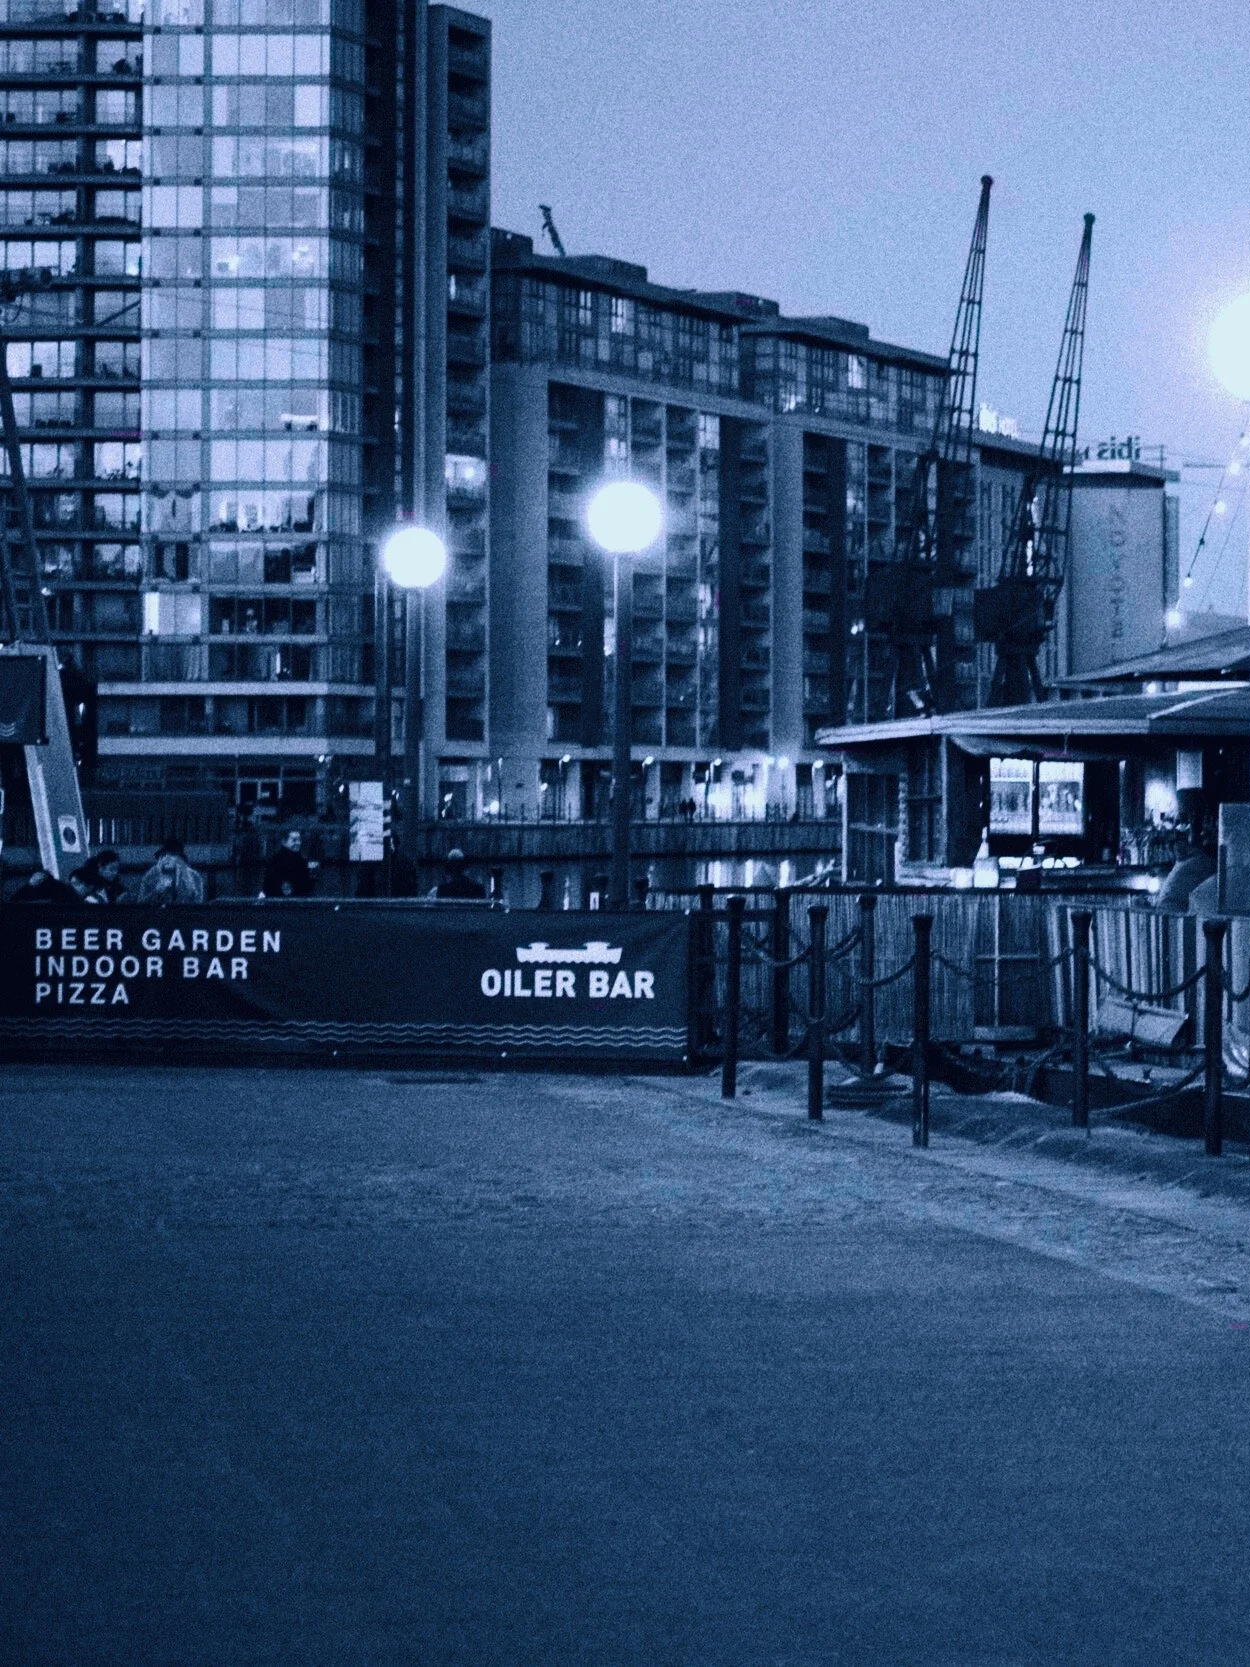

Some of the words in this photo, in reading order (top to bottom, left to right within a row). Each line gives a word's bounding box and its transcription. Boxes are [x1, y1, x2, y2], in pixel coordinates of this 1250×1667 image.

[35, 929, 123, 951] BEER
[141, 929, 281, 952] GARDEN
[34, 956, 164, 978] INDOOR
[183, 956, 249, 979] BAR
[35, 982, 129, 1004] PIZZA
[481, 968, 576, 998] OILER
[589, 970, 655, 999] BAR
